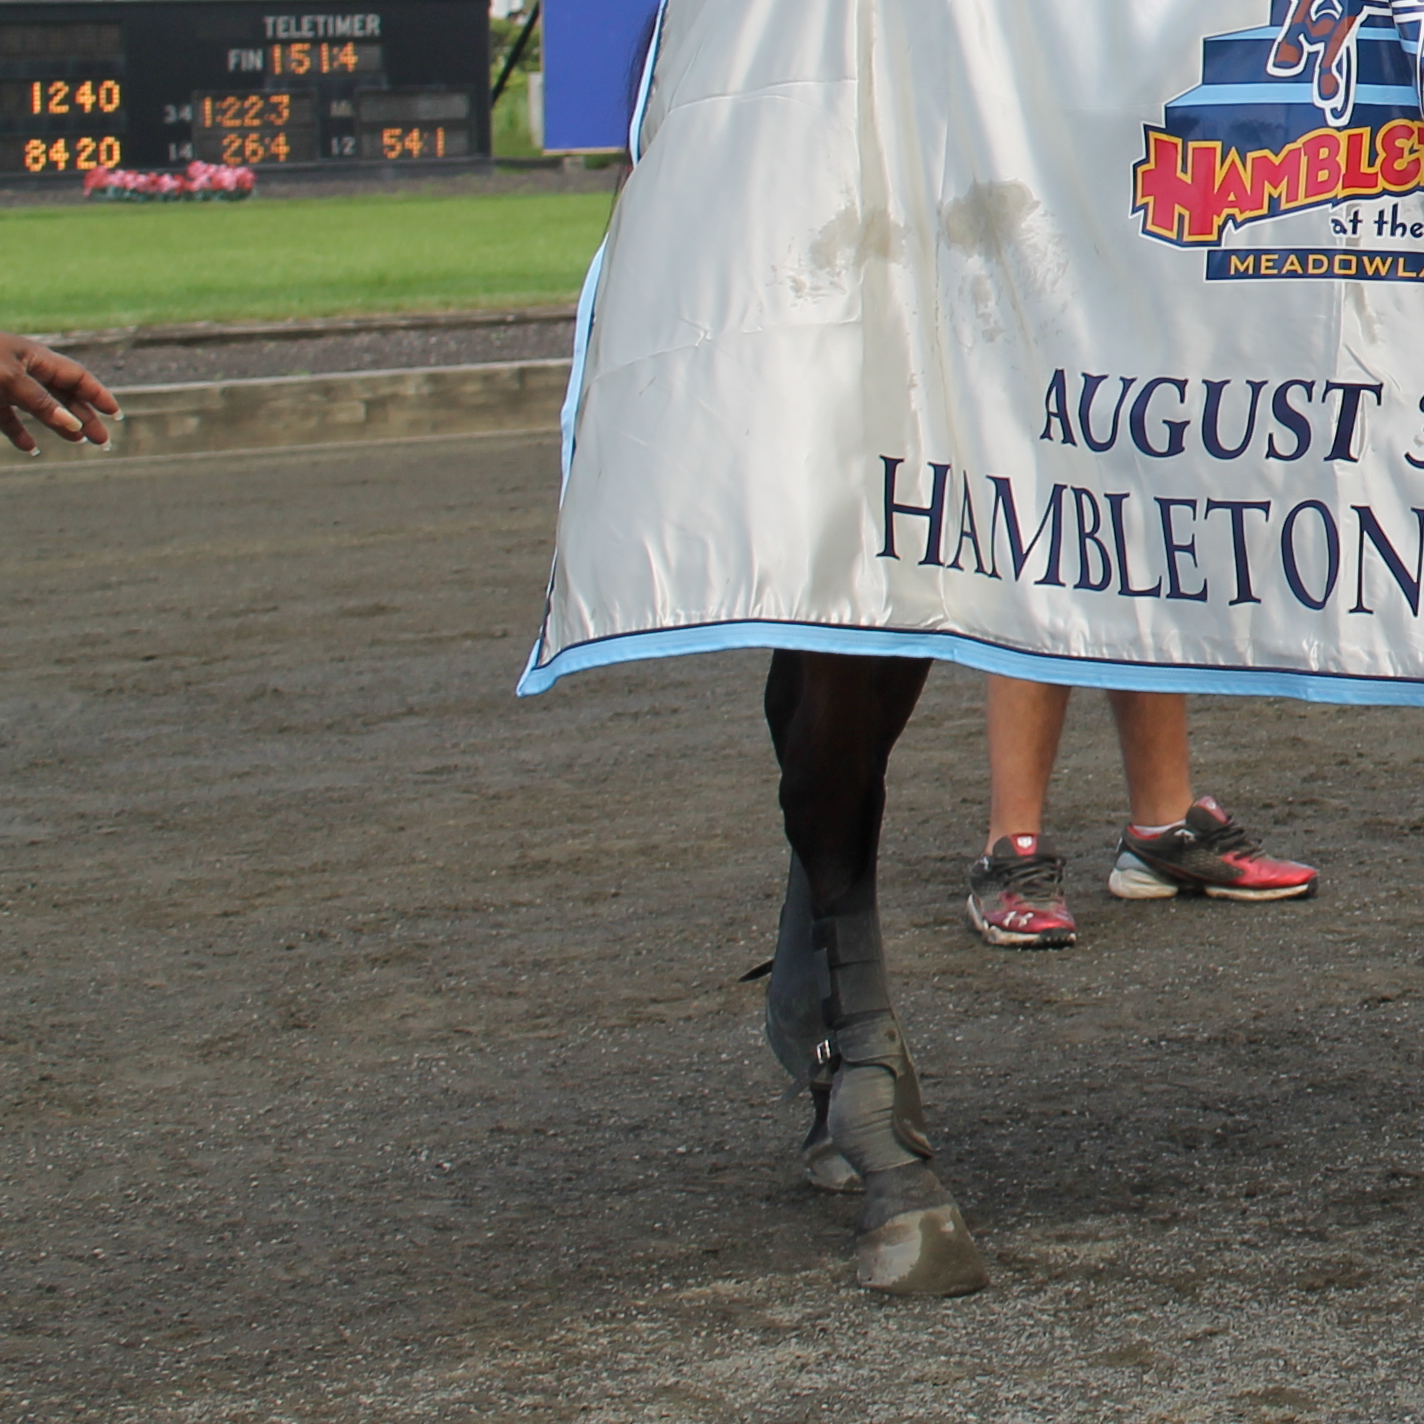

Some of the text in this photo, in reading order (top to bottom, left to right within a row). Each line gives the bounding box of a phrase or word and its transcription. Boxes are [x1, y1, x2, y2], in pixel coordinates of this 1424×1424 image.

[264, 14, 382, 40] TELETIMER
[228, 48, 263, 72] FIN
[31, 80, 120, 114] 1240
[24, 136, 121, 172] 8420
[1330, 202, 1424, 239] at the
[1039, 368, 1384, 463] AUGUST
